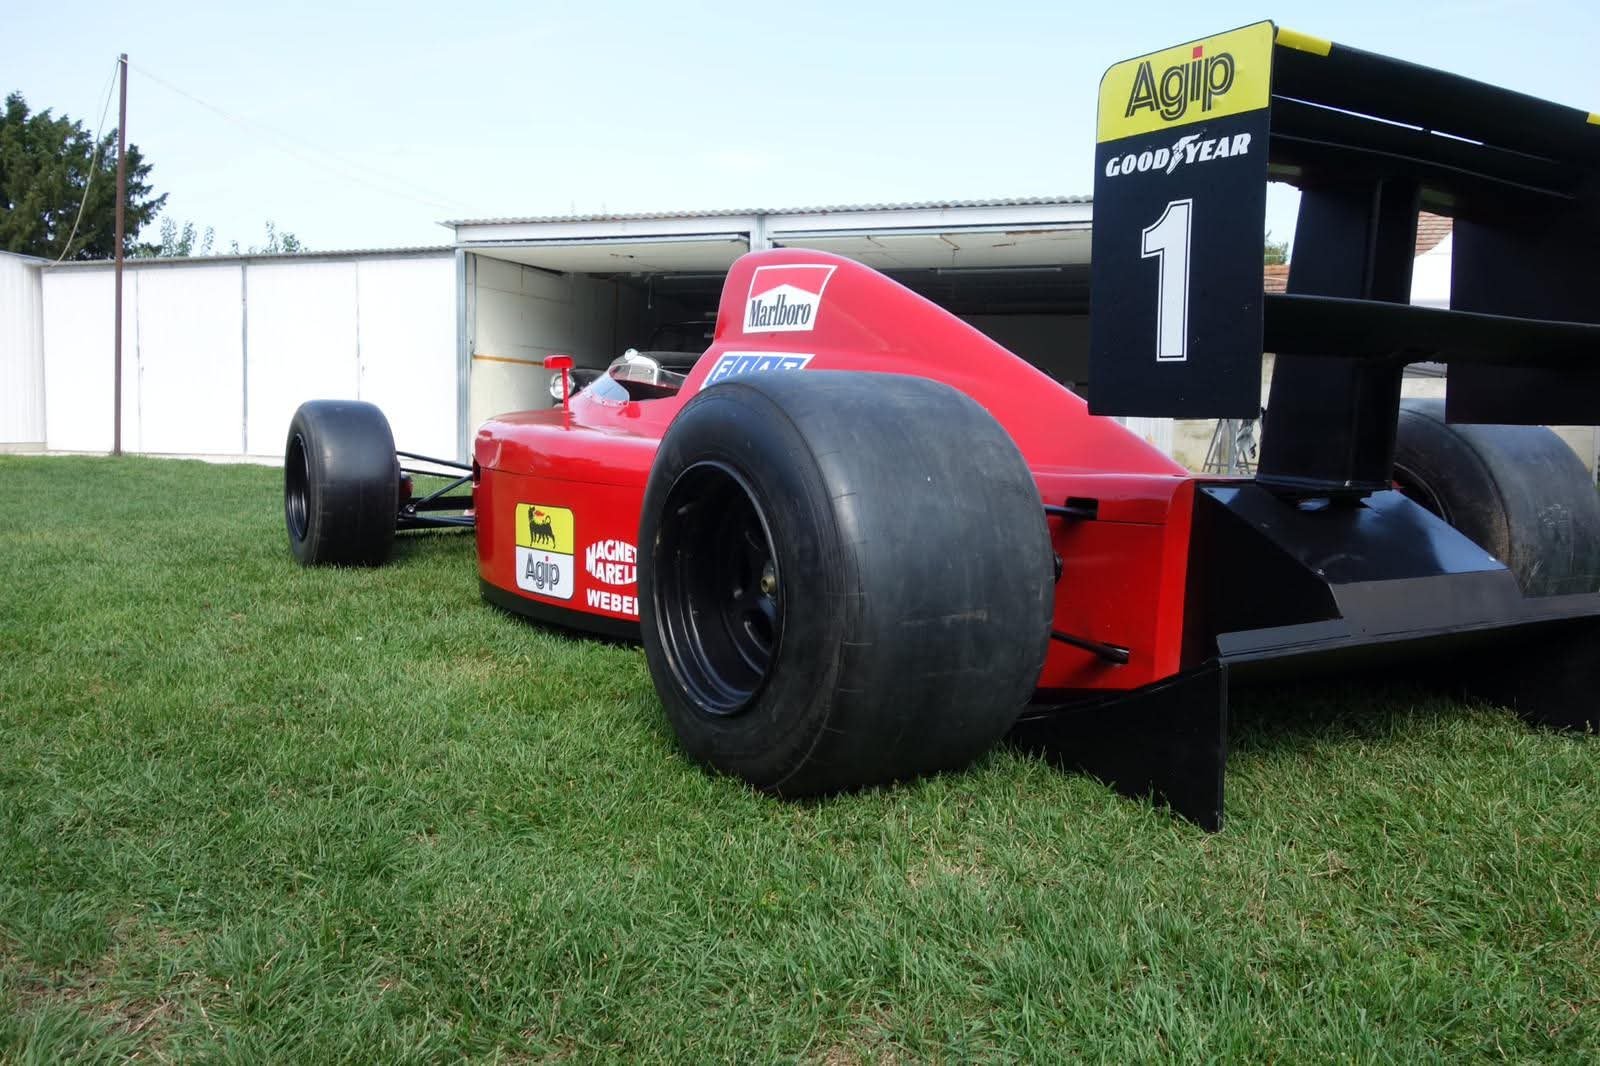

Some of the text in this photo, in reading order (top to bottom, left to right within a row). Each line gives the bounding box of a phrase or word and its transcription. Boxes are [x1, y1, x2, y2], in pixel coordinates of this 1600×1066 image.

[1125, 45, 1235, 122] Agip
[1105, 133, 1252, 177] GOODYEAR
[1141, 198, 1193, 362] 1
[749, 294, 811, 327] Marlboro
[525, 552, 560, 591] Agip
